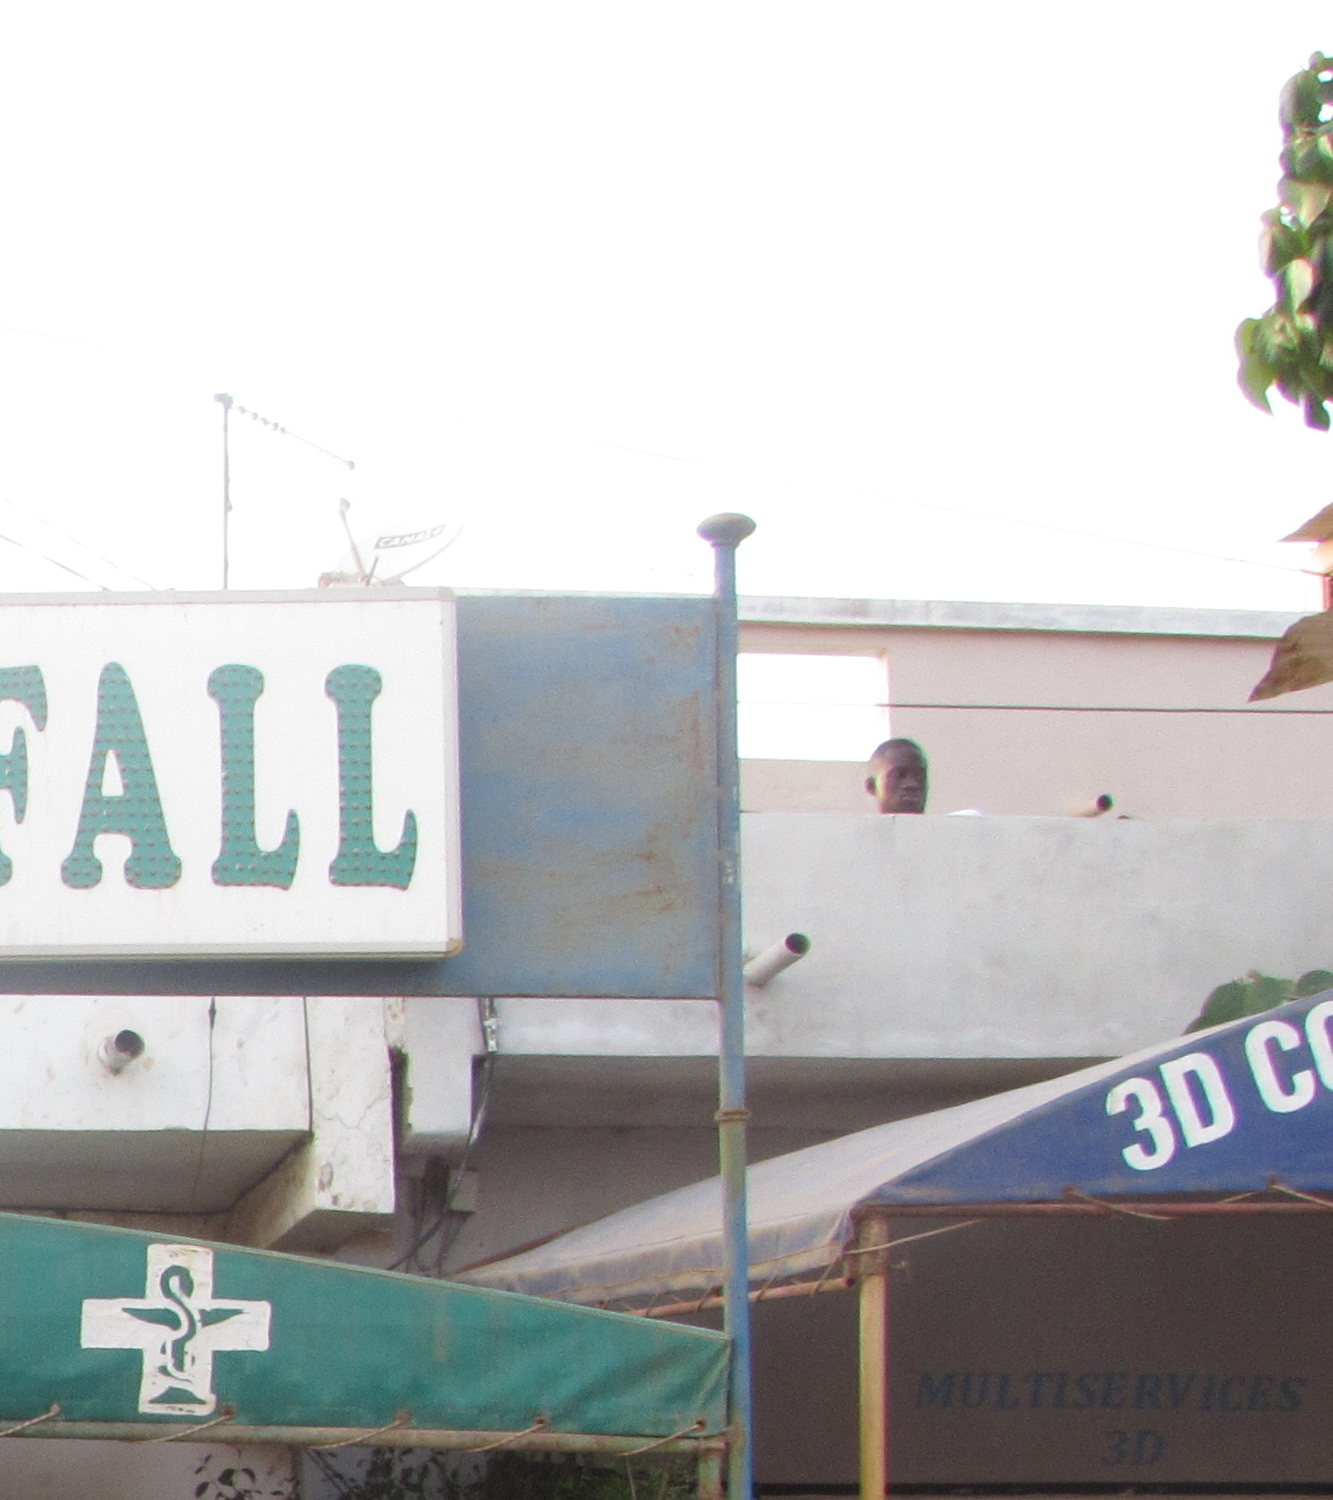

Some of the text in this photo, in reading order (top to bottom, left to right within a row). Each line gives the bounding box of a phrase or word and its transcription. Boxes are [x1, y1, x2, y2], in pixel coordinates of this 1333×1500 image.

[1106, 1051, 1236, 1170] 3D
[915, 1370, 1309, 1413] MULTISERVICES
[1101, 1428, 1167, 1467] 3D
